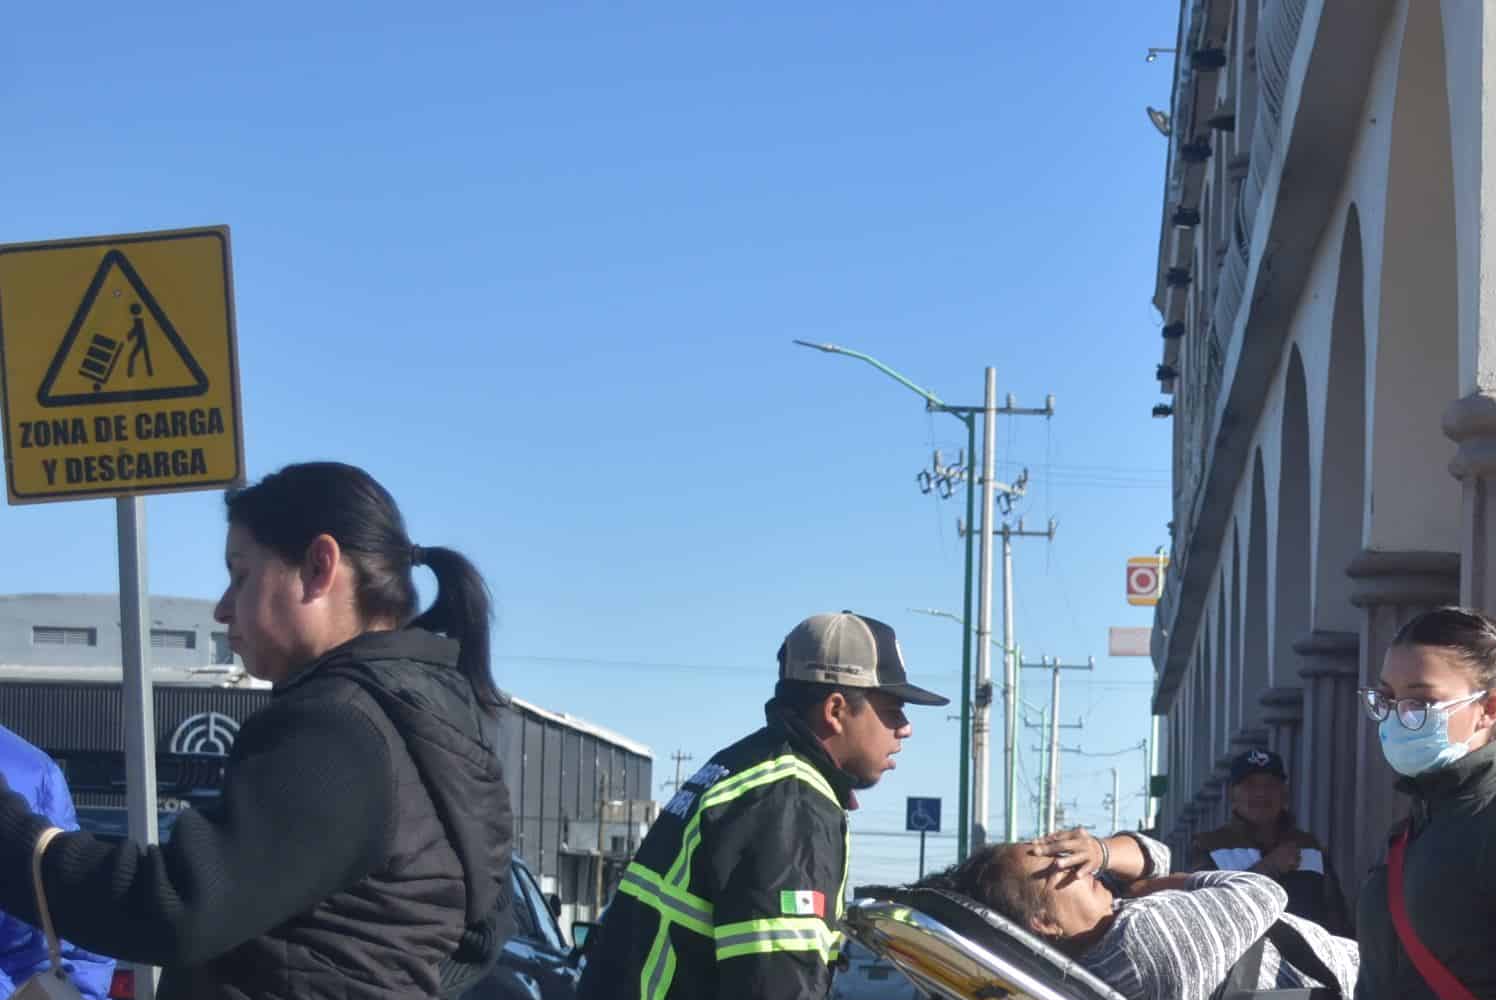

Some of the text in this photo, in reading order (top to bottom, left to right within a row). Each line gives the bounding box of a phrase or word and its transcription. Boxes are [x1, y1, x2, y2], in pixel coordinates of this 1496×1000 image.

[19, 408, 224, 448] ZONA DE CARGA
[42, 448, 208, 485] Y DESCARGA
